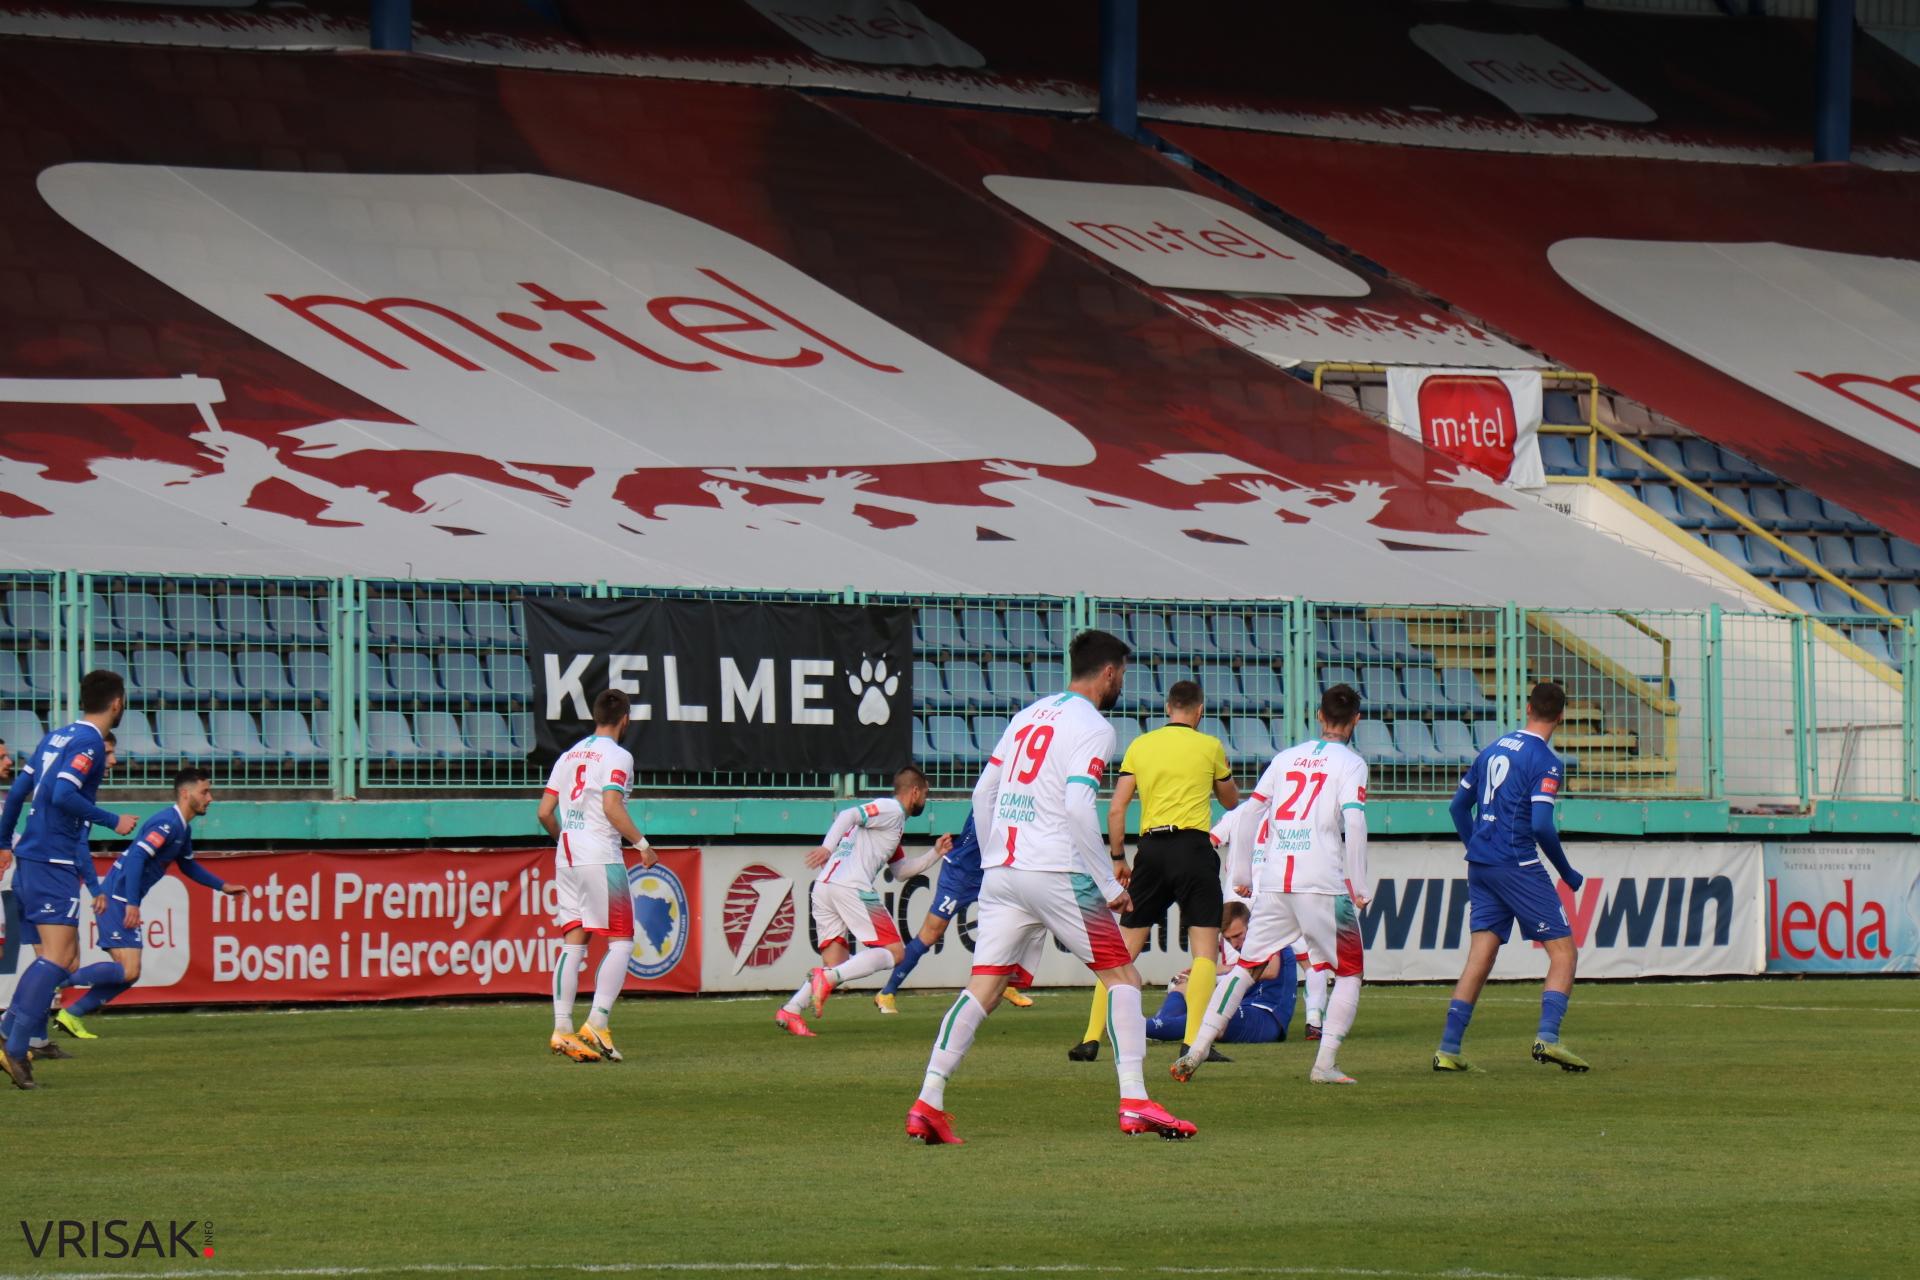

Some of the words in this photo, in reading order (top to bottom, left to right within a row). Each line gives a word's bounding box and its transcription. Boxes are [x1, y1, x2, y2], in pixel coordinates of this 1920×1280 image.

[1464, 59, 1612, 93] m:tel
[1068, 219, 1296, 260] m:tel
[264, 267, 904, 373] m:tel
[1431, 407, 1506, 448] m:tel
[543, 653, 835, 725] KELME
[1007, 724, 1054, 785] 19
[1482, 753, 1510, 804] 19
[570, 764, 587, 801] 8
[1274, 771, 1328, 821] 27
[212, 871, 320, 923] m:tel
[334, 870, 503, 929] Premijer
[938, 895, 957, 915] 24
[1767, 877, 1893, 961] leda
[213, 935, 330, 982] Bosne
[341, 931, 350, 977] i
